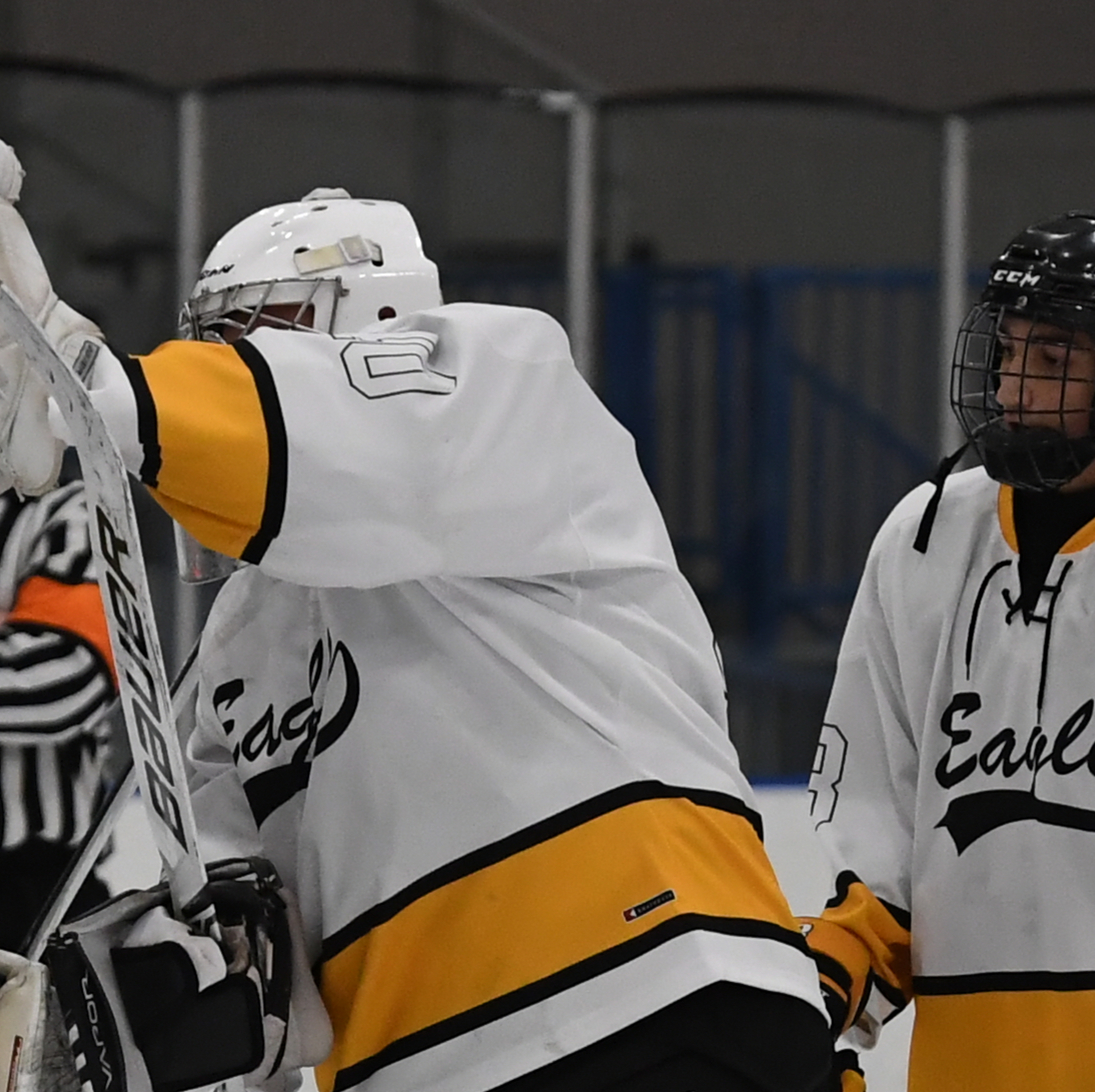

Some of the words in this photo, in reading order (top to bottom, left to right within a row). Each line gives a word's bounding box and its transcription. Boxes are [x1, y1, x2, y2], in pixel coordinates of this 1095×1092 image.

[993, 269, 1041, 287] CCM
[96, 505, 190, 854] BAUER
[934, 691, 1095, 790] Eagl
[80, 968, 113, 1090] VAPOR
